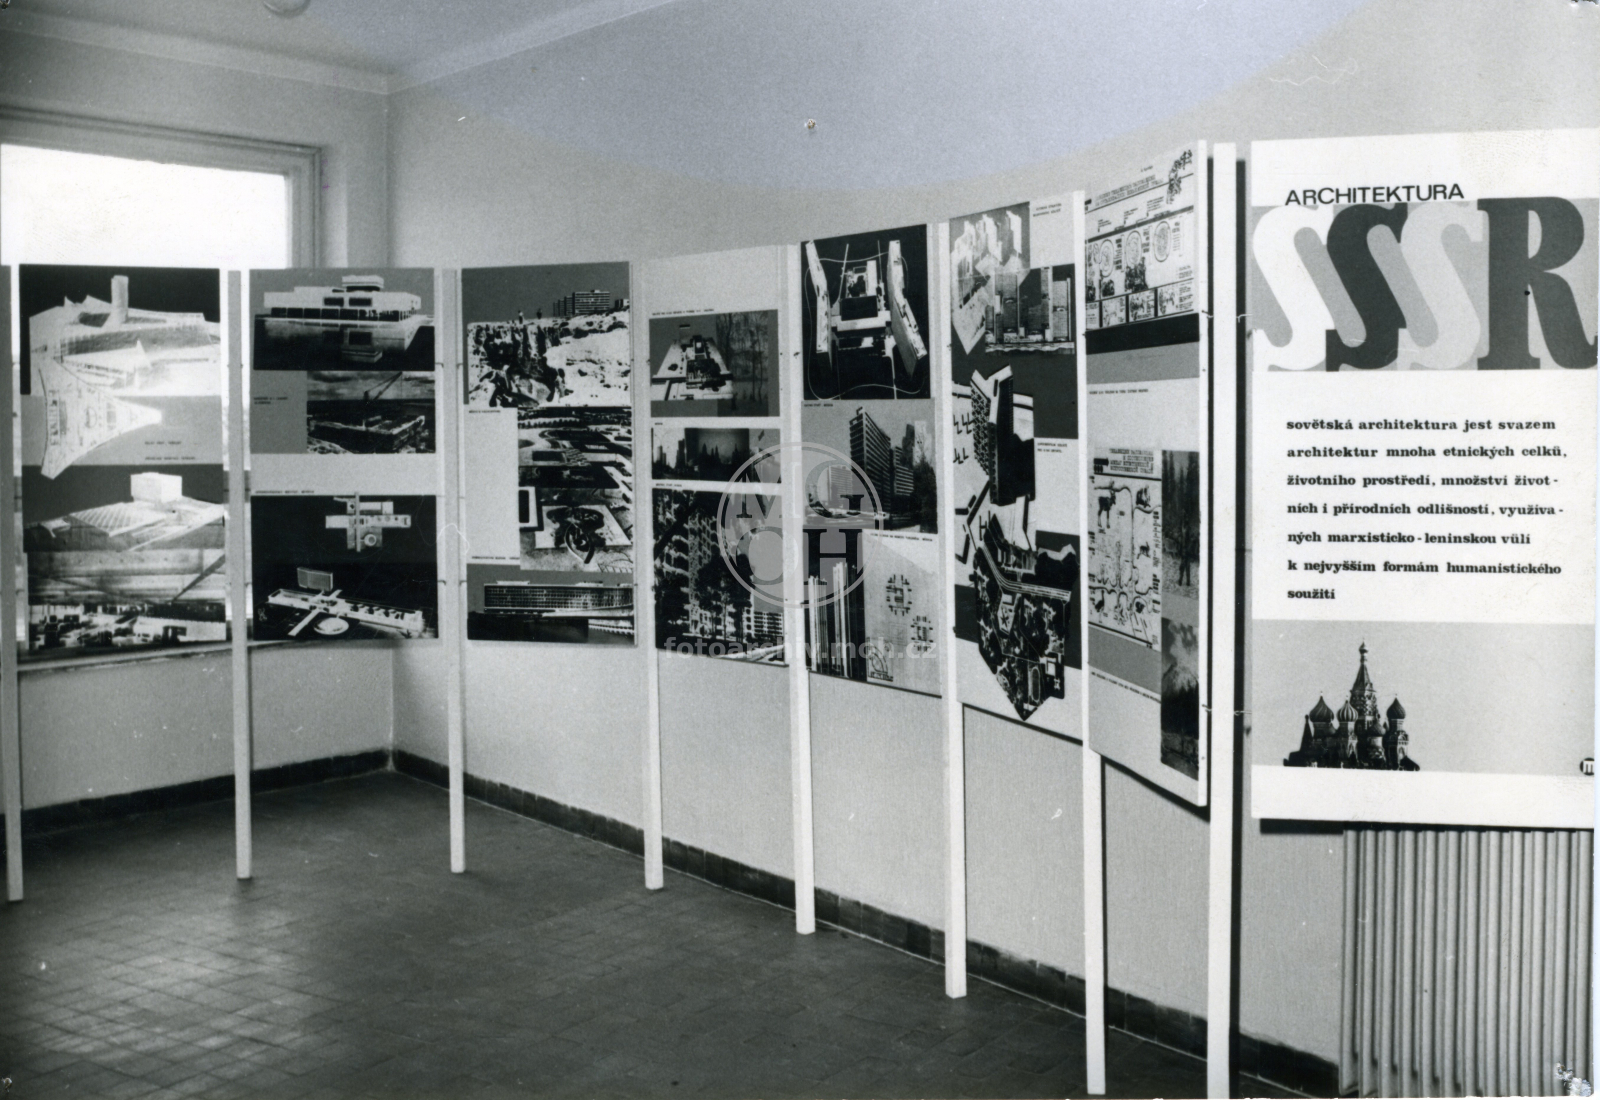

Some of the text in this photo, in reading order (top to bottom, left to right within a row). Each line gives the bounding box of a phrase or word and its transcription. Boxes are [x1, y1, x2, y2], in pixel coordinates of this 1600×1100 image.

[1284, 184, 1465, 206] ARCHITEKTURA
[1252, 197, 1598, 371] SSSR
[1286, 418, 1557, 433] sovětská architektura jest svazem
[1286, 445, 1379, 458] architektur
[1386, 446, 1436, 458] mnoha
[1442, 445, 1515, 460] etnických
[1286, 473, 1357, 486] životního
[1362, 473, 1436, 489] prostředí,
[1441, 474, 1508, 487] množství
[1286, 502, 1319, 515] ních
[1322, 502, 1328, 515] i
[1333, 502, 1411, 517] přírodních
[1287, 530, 1322, 545] ných
[1287, 558, 1562, 575] k nejvyšším formám humanistického
[1286, 587, 1336, 600] soužití
